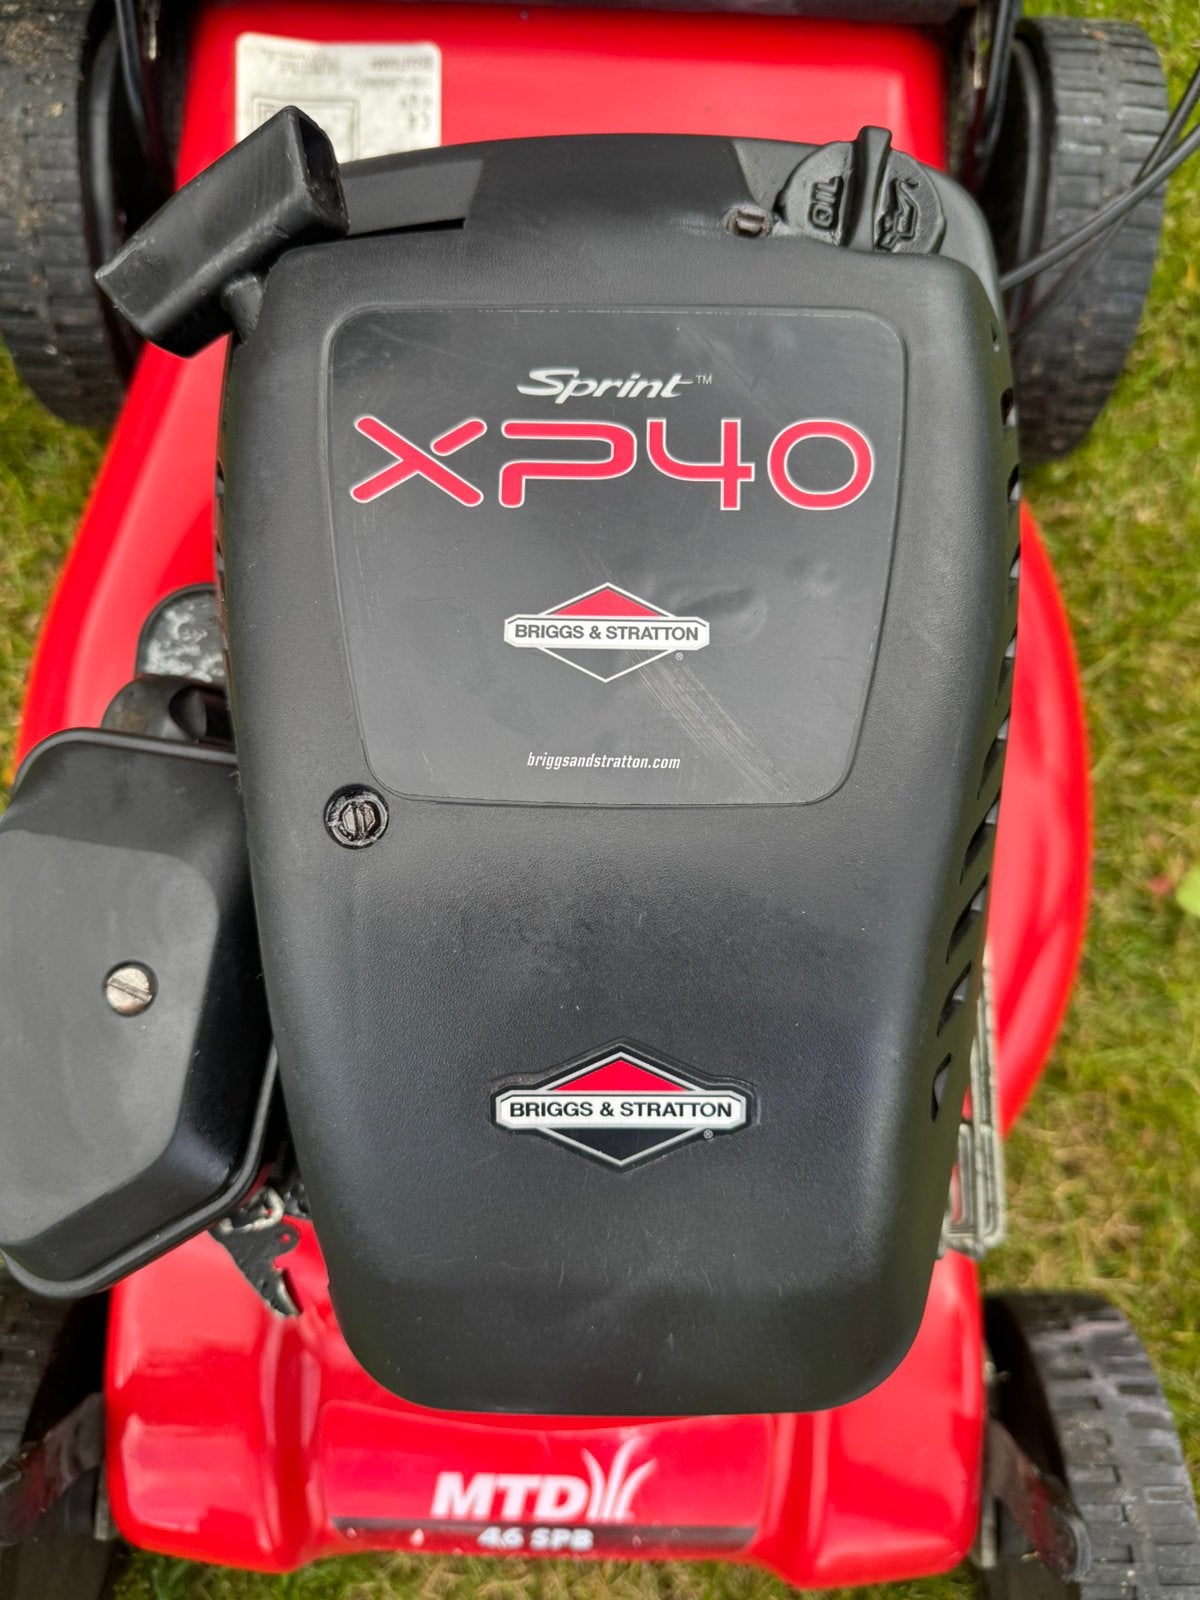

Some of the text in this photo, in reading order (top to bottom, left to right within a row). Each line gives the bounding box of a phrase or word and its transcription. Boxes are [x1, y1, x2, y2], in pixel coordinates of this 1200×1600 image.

[812, 176, 839, 229] OIL
[350, 416, 875, 510] XP40
[514, 624, 699, 641] BRIGGS & STRATTON
[526, 752, 681, 770] briggsandstratton.com
[509, 1102, 732, 1118] BRIGGS & STRATTON
[431, 1472, 588, 1520] MTD
[530, 1528, 594, 1550] SPB
